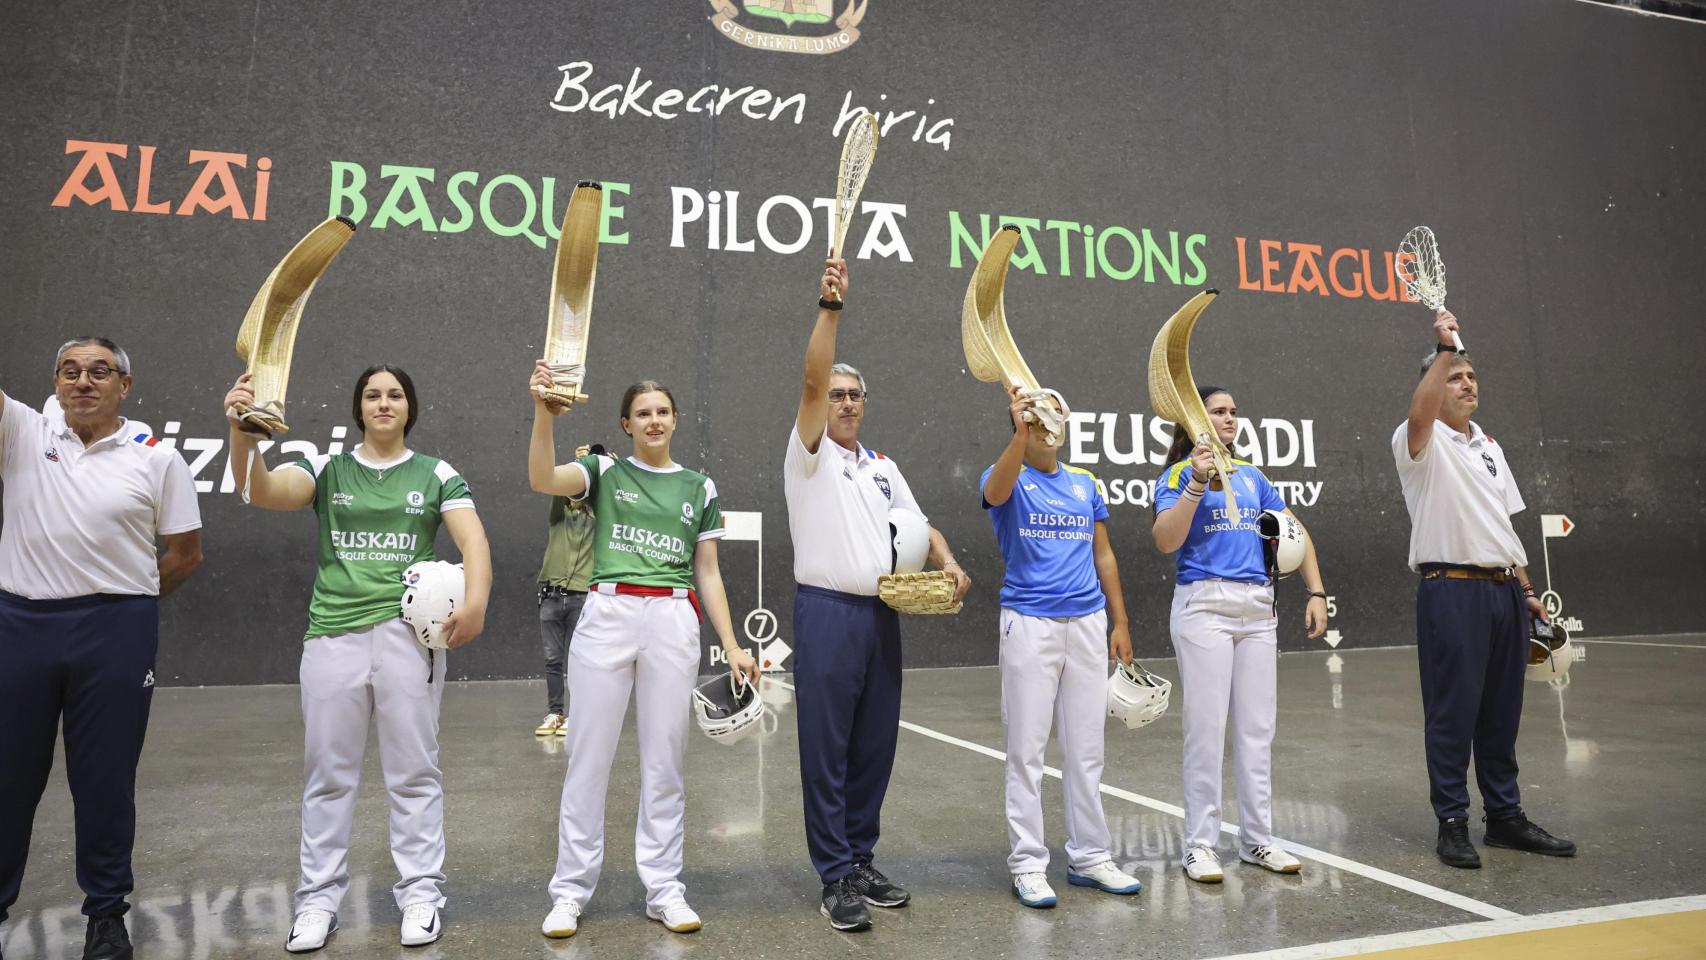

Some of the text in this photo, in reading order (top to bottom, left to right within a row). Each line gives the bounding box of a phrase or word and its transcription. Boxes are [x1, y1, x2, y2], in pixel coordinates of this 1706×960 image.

[805, 32, 850, 51] LUMO
[550, 61, 806, 124] Bakearen
[1236, 236, 1420, 302] LEAGUE
[1067, 411, 1317, 468] EUSADI
[1029, 513, 1089, 528] EUSKADI
[331, 530, 417, 550] EUSKADI
[612, 523, 685, 556] EUSKADI
[1019, 528, 1056, 539] BASQUE
[335, 550, 415, 563] ASQUE COUNTRY
[609, 541, 644, 554] BASQUE
[1325, 595, 1337, 618] 5
[1546, 595, 1556, 613] 4
[754, 615, 768, 638] 7
